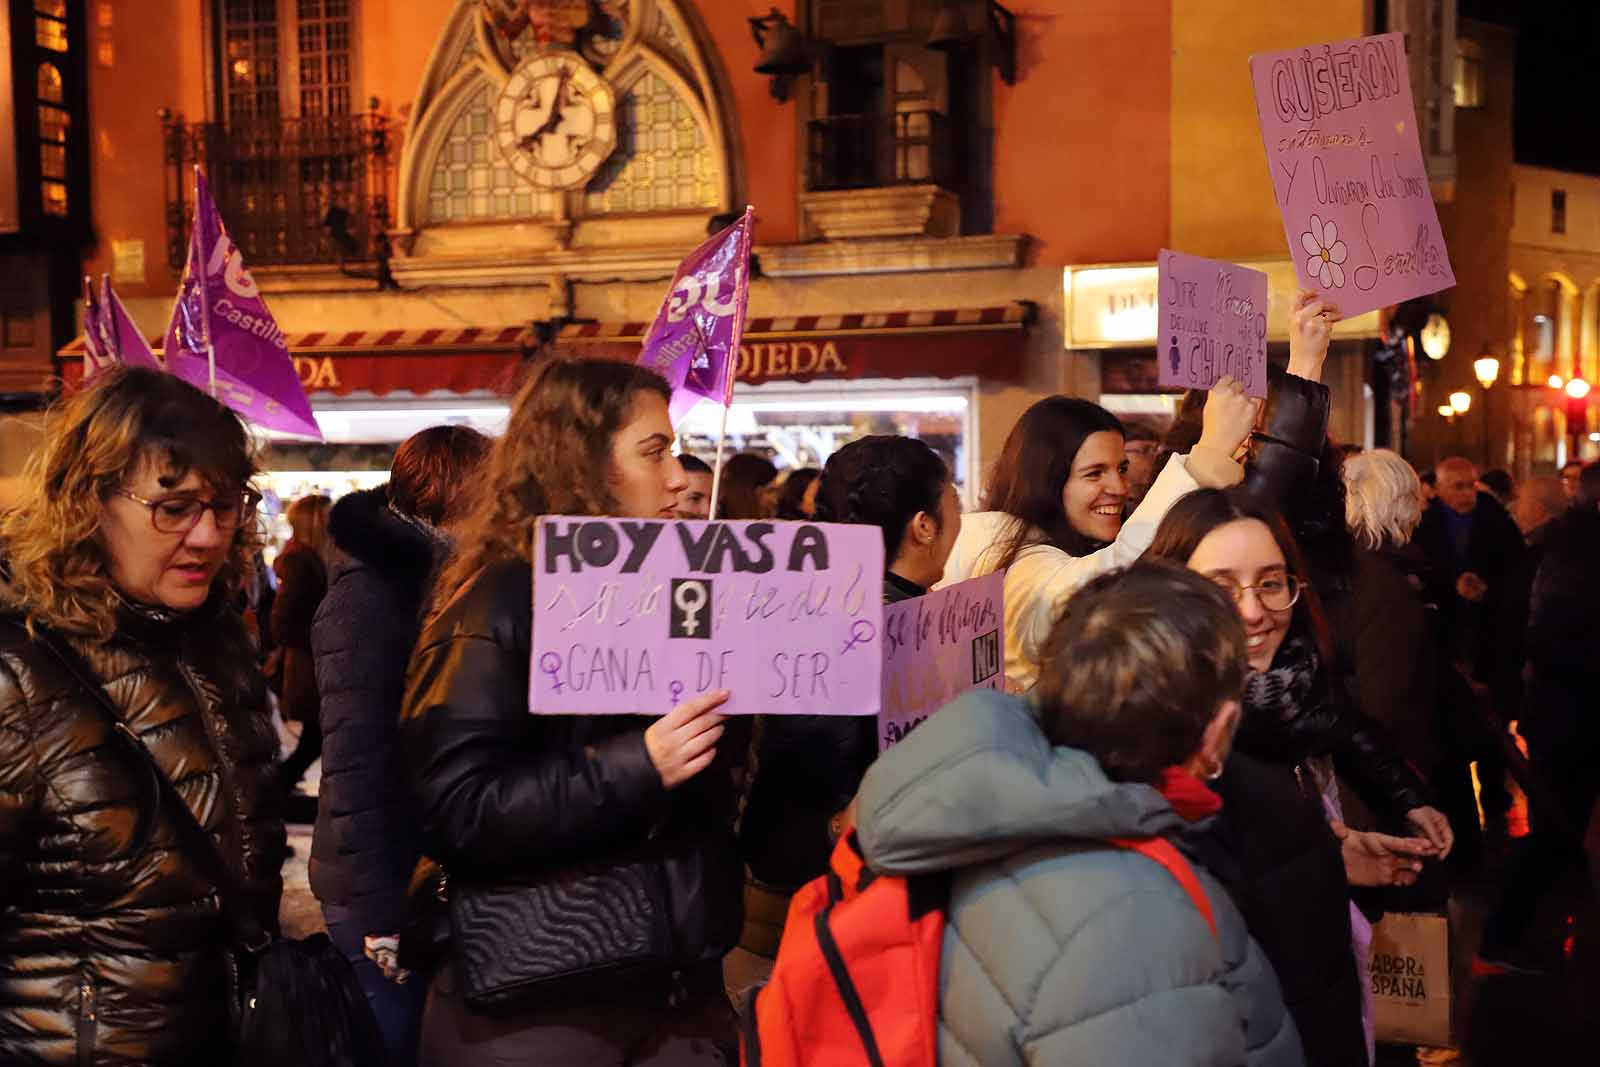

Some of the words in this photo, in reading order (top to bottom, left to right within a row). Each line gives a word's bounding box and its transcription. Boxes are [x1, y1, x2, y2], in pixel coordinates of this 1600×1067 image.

[1279, 160, 1300, 206] Y
[544, 522, 665, 574] HOY
[675, 522, 775, 574] VAS
[786, 525, 830, 572] A
[566, 643, 656, 693] GANA
[1369, 953, 1416, 977] ABOR
[1371, 975, 1427, 1001] SPAÑA
